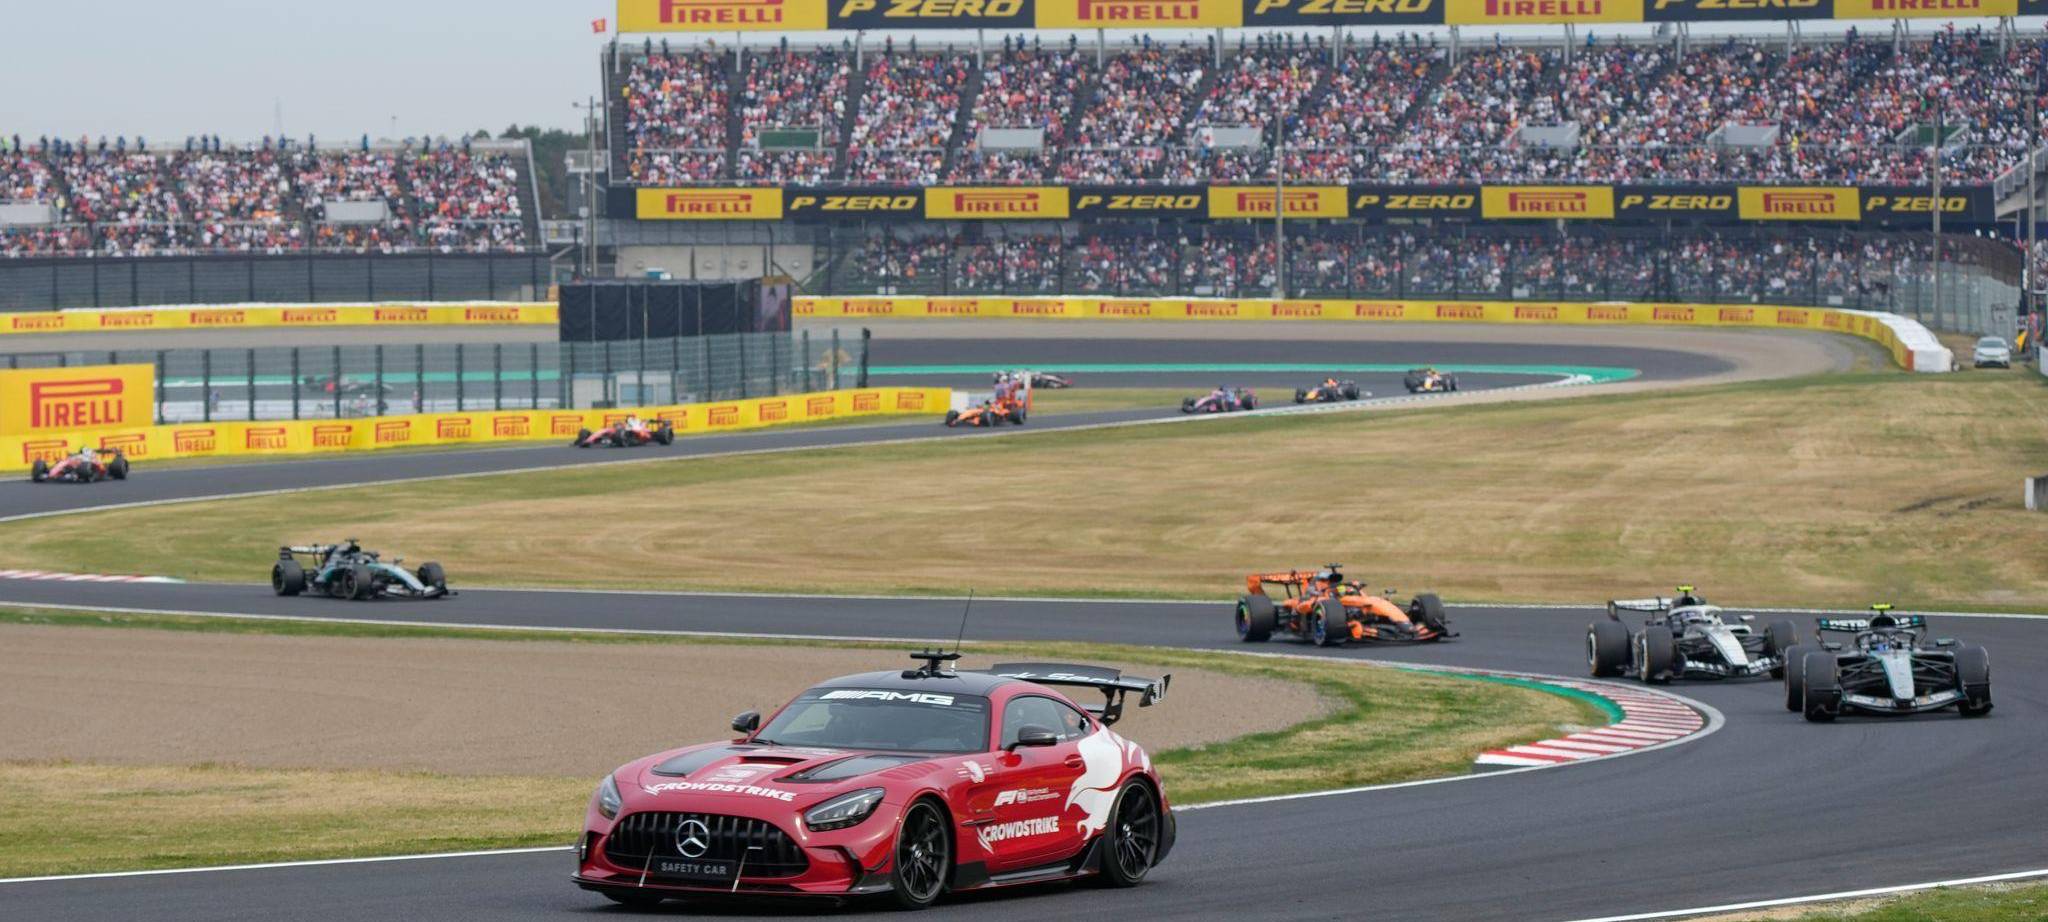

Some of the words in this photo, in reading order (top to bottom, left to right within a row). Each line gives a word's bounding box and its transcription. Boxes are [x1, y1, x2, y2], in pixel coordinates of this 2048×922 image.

[659, 0, 783, 24] PIRELLI
[838, 0, 877, 17] P
[883, 0, 1023, 17] ZERO
[1077, 0, 1199, 21] PIRELLI
[666, 194, 753, 213] PIRELLI
[790, 196, 817, 211] P
[822, 196, 918, 210] ZERO
[954, 192, 1039, 212] PIRELLI
[1076, 195, 1102, 209] P
[1107, 195, 1200, 209] ZERO
[1237, 192, 1319, 211] PIRLLI
[1356, 195, 1380, 209] P
[1386, 195, 1474, 209] ZERO
[1508, 192, 1587, 212] PIRELLI
[1621, 195, 1645, 209] P
[1649, 195, 1732, 209] ZERO
[1763, 193, 1835, 213] PIRELLI
[1866, 196, 1887, 211] P
[1891, 196, 1967, 211] ZERO
[374, 309, 428, 321] PIRELLI
[465, 308, 520, 320] PIRELLI
[843, 302, 893, 313] PIRELLI
[927, 302, 978, 313] PIRELLI
[1012, 302, 1065, 314] PIRELLI
[1100, 302, 1150, 314] PIRELLI
[1186, 303, 1238, 315] PIRELLI
[1272, 304, 1322, 316] PIRELLI
[1355, 305, 1404, 317] PIRELLI
[1436, 305, 1484, 318] PIRELLI
[1514, 306, 1558, 319] PIRELLI
[1587, 307, 1628, 319] PIRELLI
[1653, 307, 1695, 320] PIRELLI
[13, 316, 64, 329] PIRELLI
[100, 314, 154, 326] PIRELLI
[190, 312, 244, 324] PIRELLI
[281, 310, 337, 322] PIRELLI
[30, 378, 124, 428] PIRELLI
[806, 397, 835, 416] PIRELLI
[853, 393, 880, 411] PIRELLI
[896, 392, 925, 409] PIRELLI
[708, 406, 739, 426] PIRELLI
[759, 402, 787, 421] PIRELLI
[375, 421, 411, 443] PIRELLI
[437, 418, 472, 438] PIRELLI
[493, 416, 529, 436] PIRELLI
[174, 429, 216, 452] PIRELLI
[246, 427, 287, 449] PIRELLI
[313, 425, 352, 447] PIRELLI
[858, 691, 954, 706] AMG
[657, 783, 797, 802] CROWDSTRIKE
[982, 816, 1059, 842] CROWDSTRIKE
[661, 862, 700, 874] SAFETY
[703, 864, 727, 875] CAR
